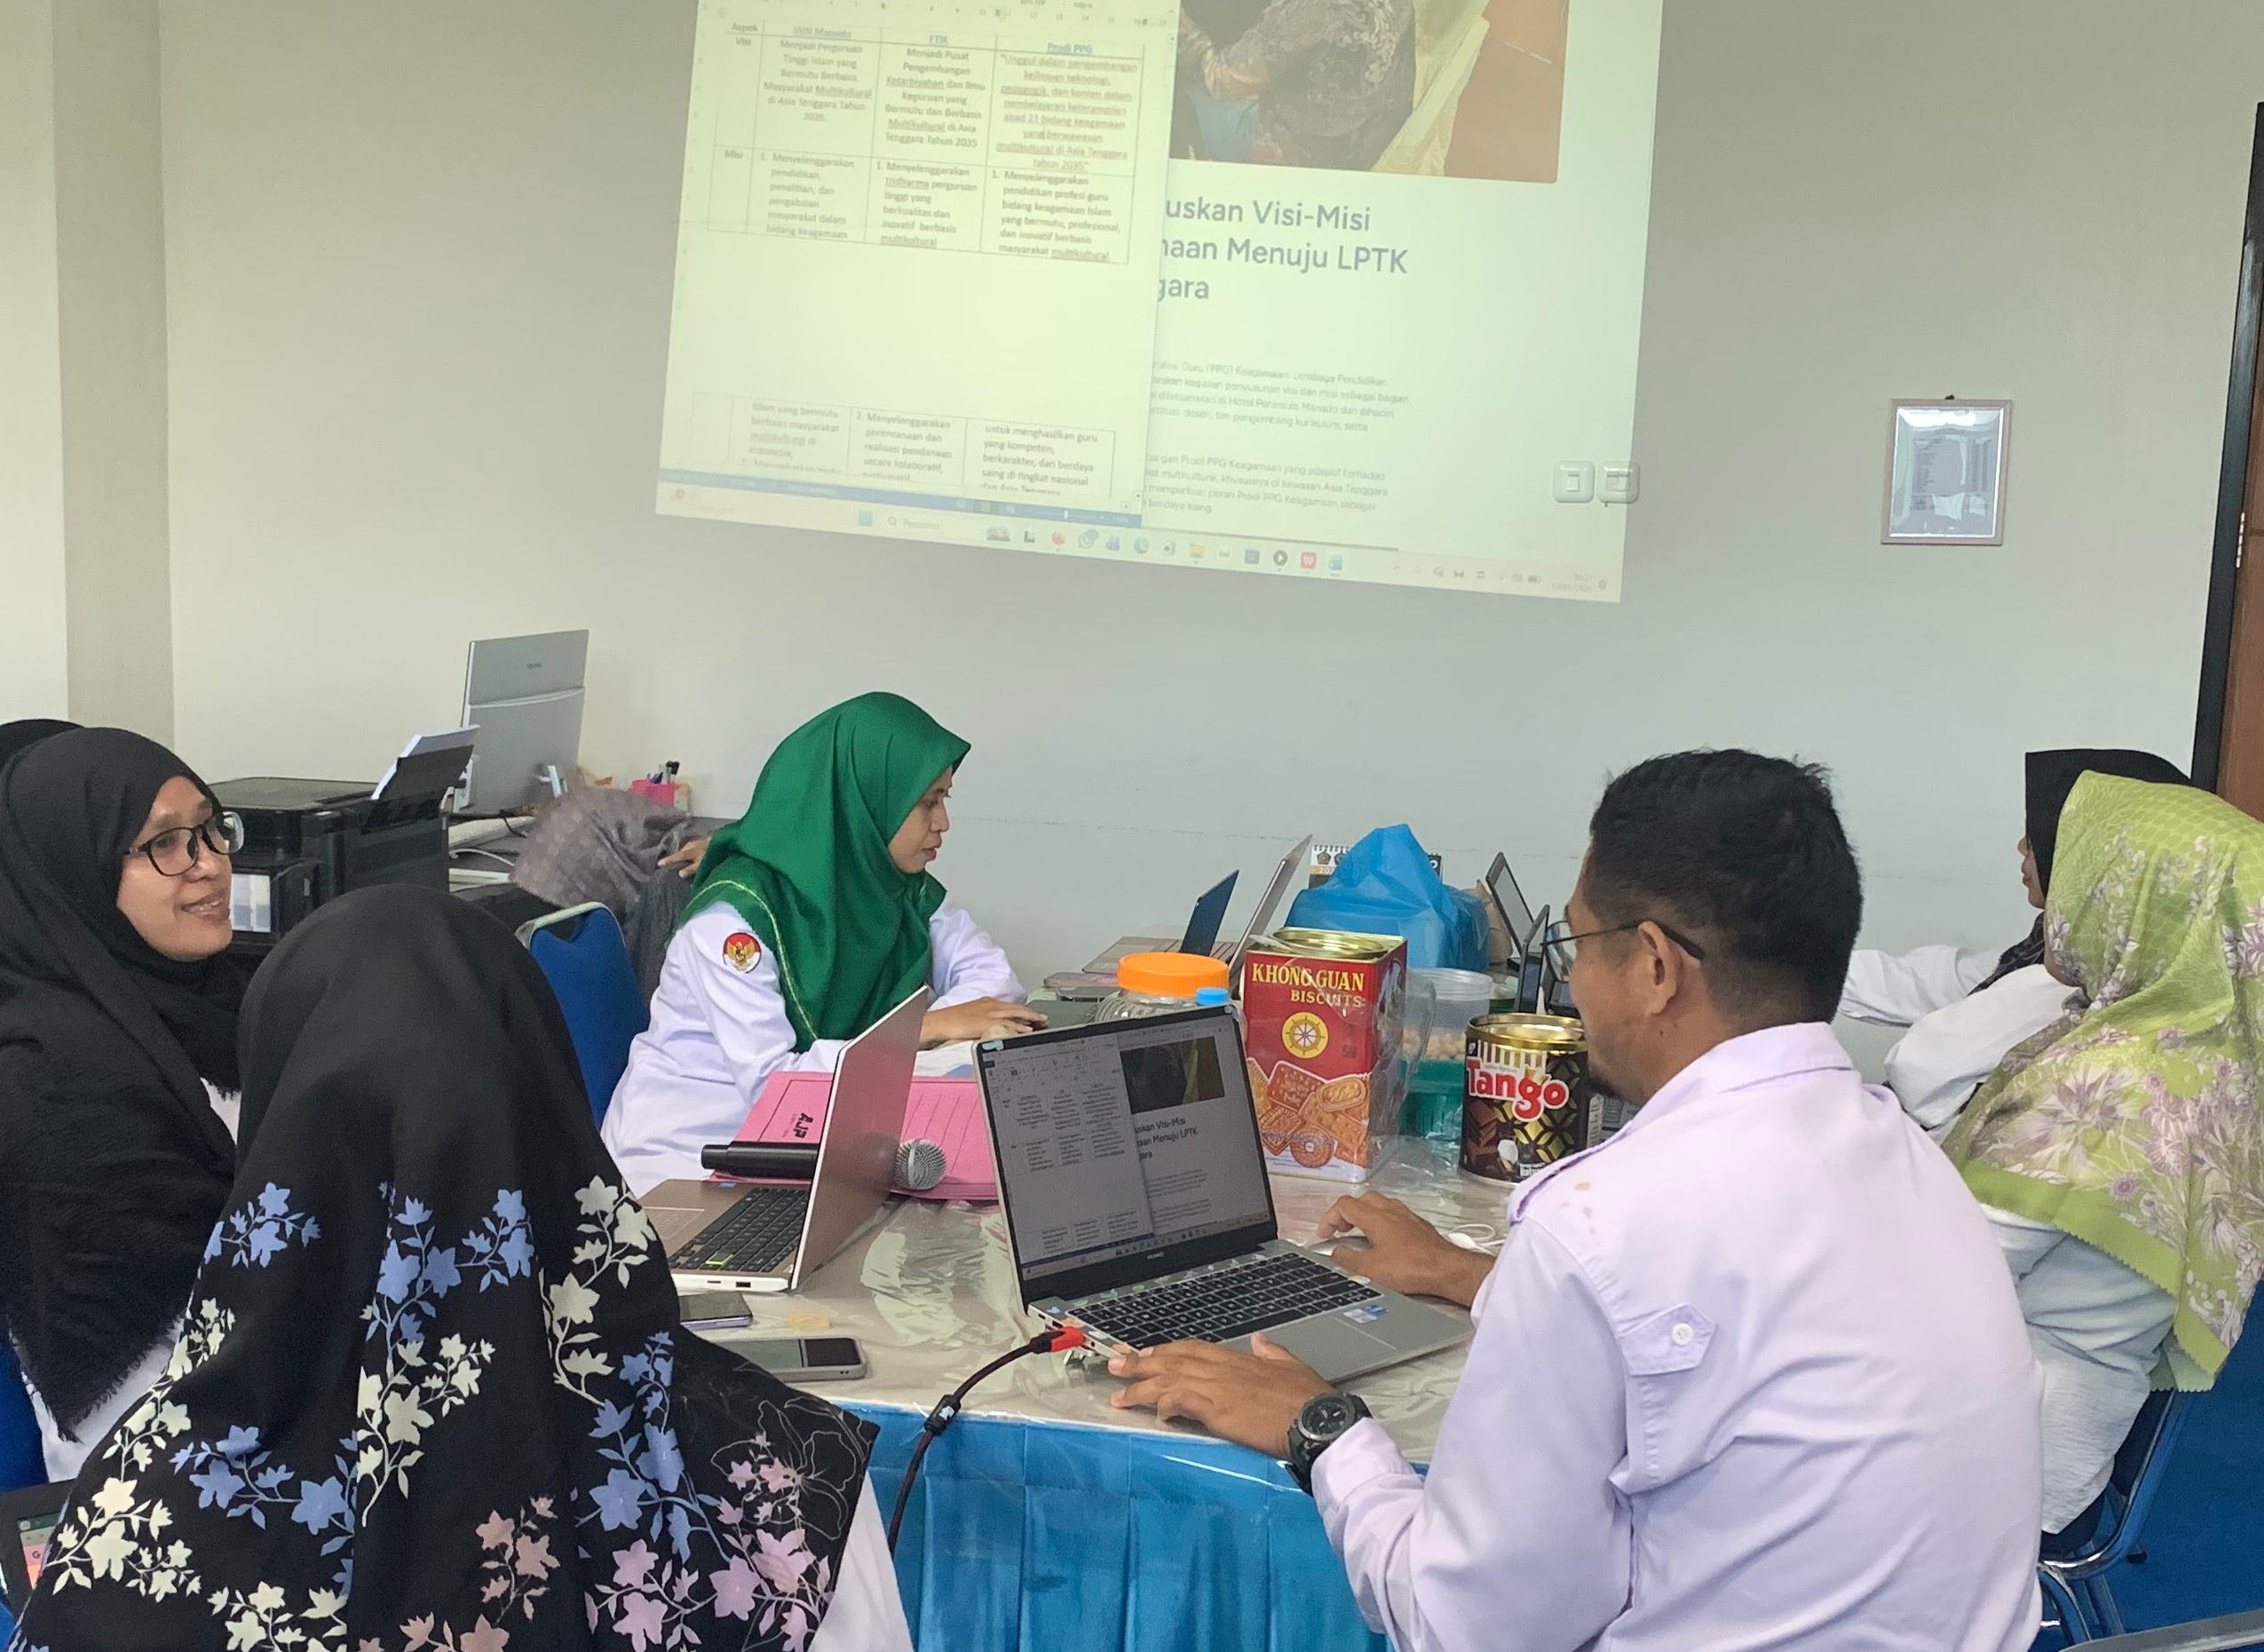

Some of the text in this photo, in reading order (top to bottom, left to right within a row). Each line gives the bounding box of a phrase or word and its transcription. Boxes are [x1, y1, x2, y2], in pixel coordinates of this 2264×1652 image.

[780, 40, 862, 53] Menjadi Perguruan
[906, 48, 970, 60] Menjadi Pusat
[783, 54, 857, 69] Tinggi Islam yang
[903, 61, 970, 76] Pengembangan
[780, 68, 818, 79] Bermutu
[764, 82, 872, 97] Masyarakat Multikultural
[946, 80, 963, 89] dan
[767, 96, 866, 111] di Asia Tenggara Tahun
[902, 91, 968, 106] Keguruan yang
[885, 103, 982, 119] Bermutu dan Berbasis
[1028, 115, 1039, 123] 21
[946, 122, 956, 131] di
[958, 123, 977, 133] Asia
[886, 131, 978, 148] Tenggara Tahun 2035
[772, 153, 854, 168] Menyelenggarakan
[886, 162, 970, 176] Menyelenggarakan
[1004, 171, 1088, 185] Menyelenggarakan
[931, 181, 978, 191] perguruan
[884, 192, 932, 204] tinggi yang
[1003, 186, 1109, 202] pendidikan profesi guru
[933, 209, 951, 218] dan
[1002, 200, 1112, 217] bidang keagamaan Islam
[1165, 196, 1371, 232] uskan Visi-Misi
[819, 214, 846, 224] dalam
[1001, 217, 1022, 226] yang
[920, 222, 956, 233] berbasis
[1000, 229, 1017, 238] dan
[1055, 233, 1091, 244] berbasis
[1227, 237, 1328, 273] Menuju
[1337, 245, 1409, 273] LPTK
[1300, 388, 1317, 397] dan
[1340, 406, 1358, 415] dan
[925, 433, 942, 442] dan
[1013, 427, 1075, 439] menghasilkan
[1077, 434, 1097, 443] guru
[984, 440, 1005, 450] yang
[1039, 459, 1056, 468] dan
[1057, 461, 1094, 472] berdaya
[1284, 466, 1306, 476] yang
[981, 469, 1005, 479] saing
[1050, 475, 1088, 486] nasional
[1252, 963, 1365, 992] KHONG GUAN
[1290, 989, 1363, 1008] BISCUITS
[1467, 1058, 1568, 1120] Tango
